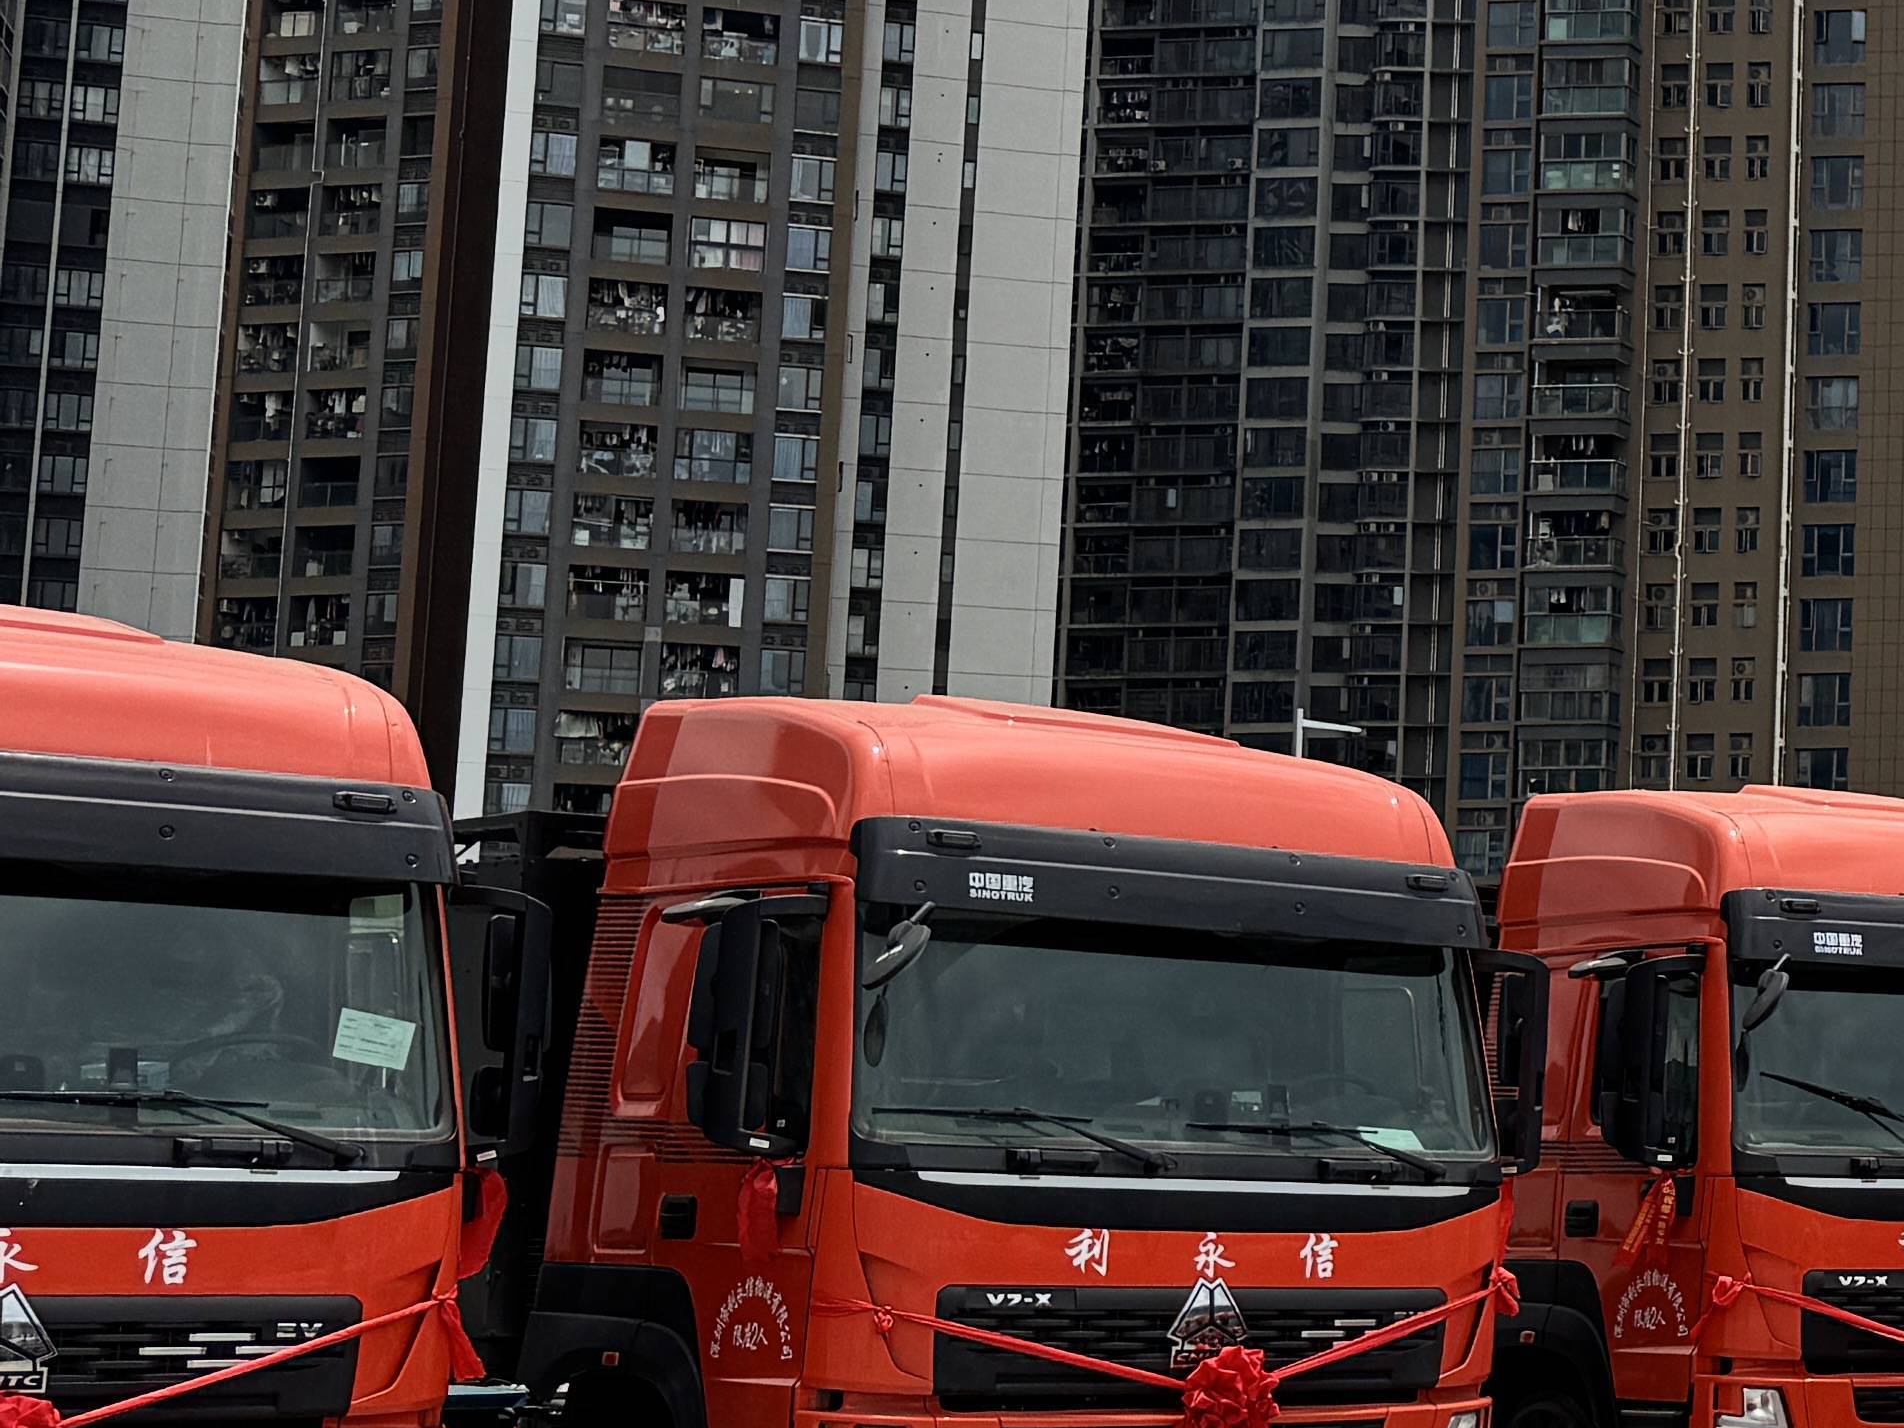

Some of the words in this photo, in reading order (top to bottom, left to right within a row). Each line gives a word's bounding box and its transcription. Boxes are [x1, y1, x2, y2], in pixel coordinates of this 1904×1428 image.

[969, 888, 1033, 902] SINOTRUK
[1065, 1228, 1338, 1278] 利永信
[1838, 1275, 1888, 1286] V7-X
[986, 1293, 1052, 1308] V7-X
[277, 1322, 323, 1338] EV
